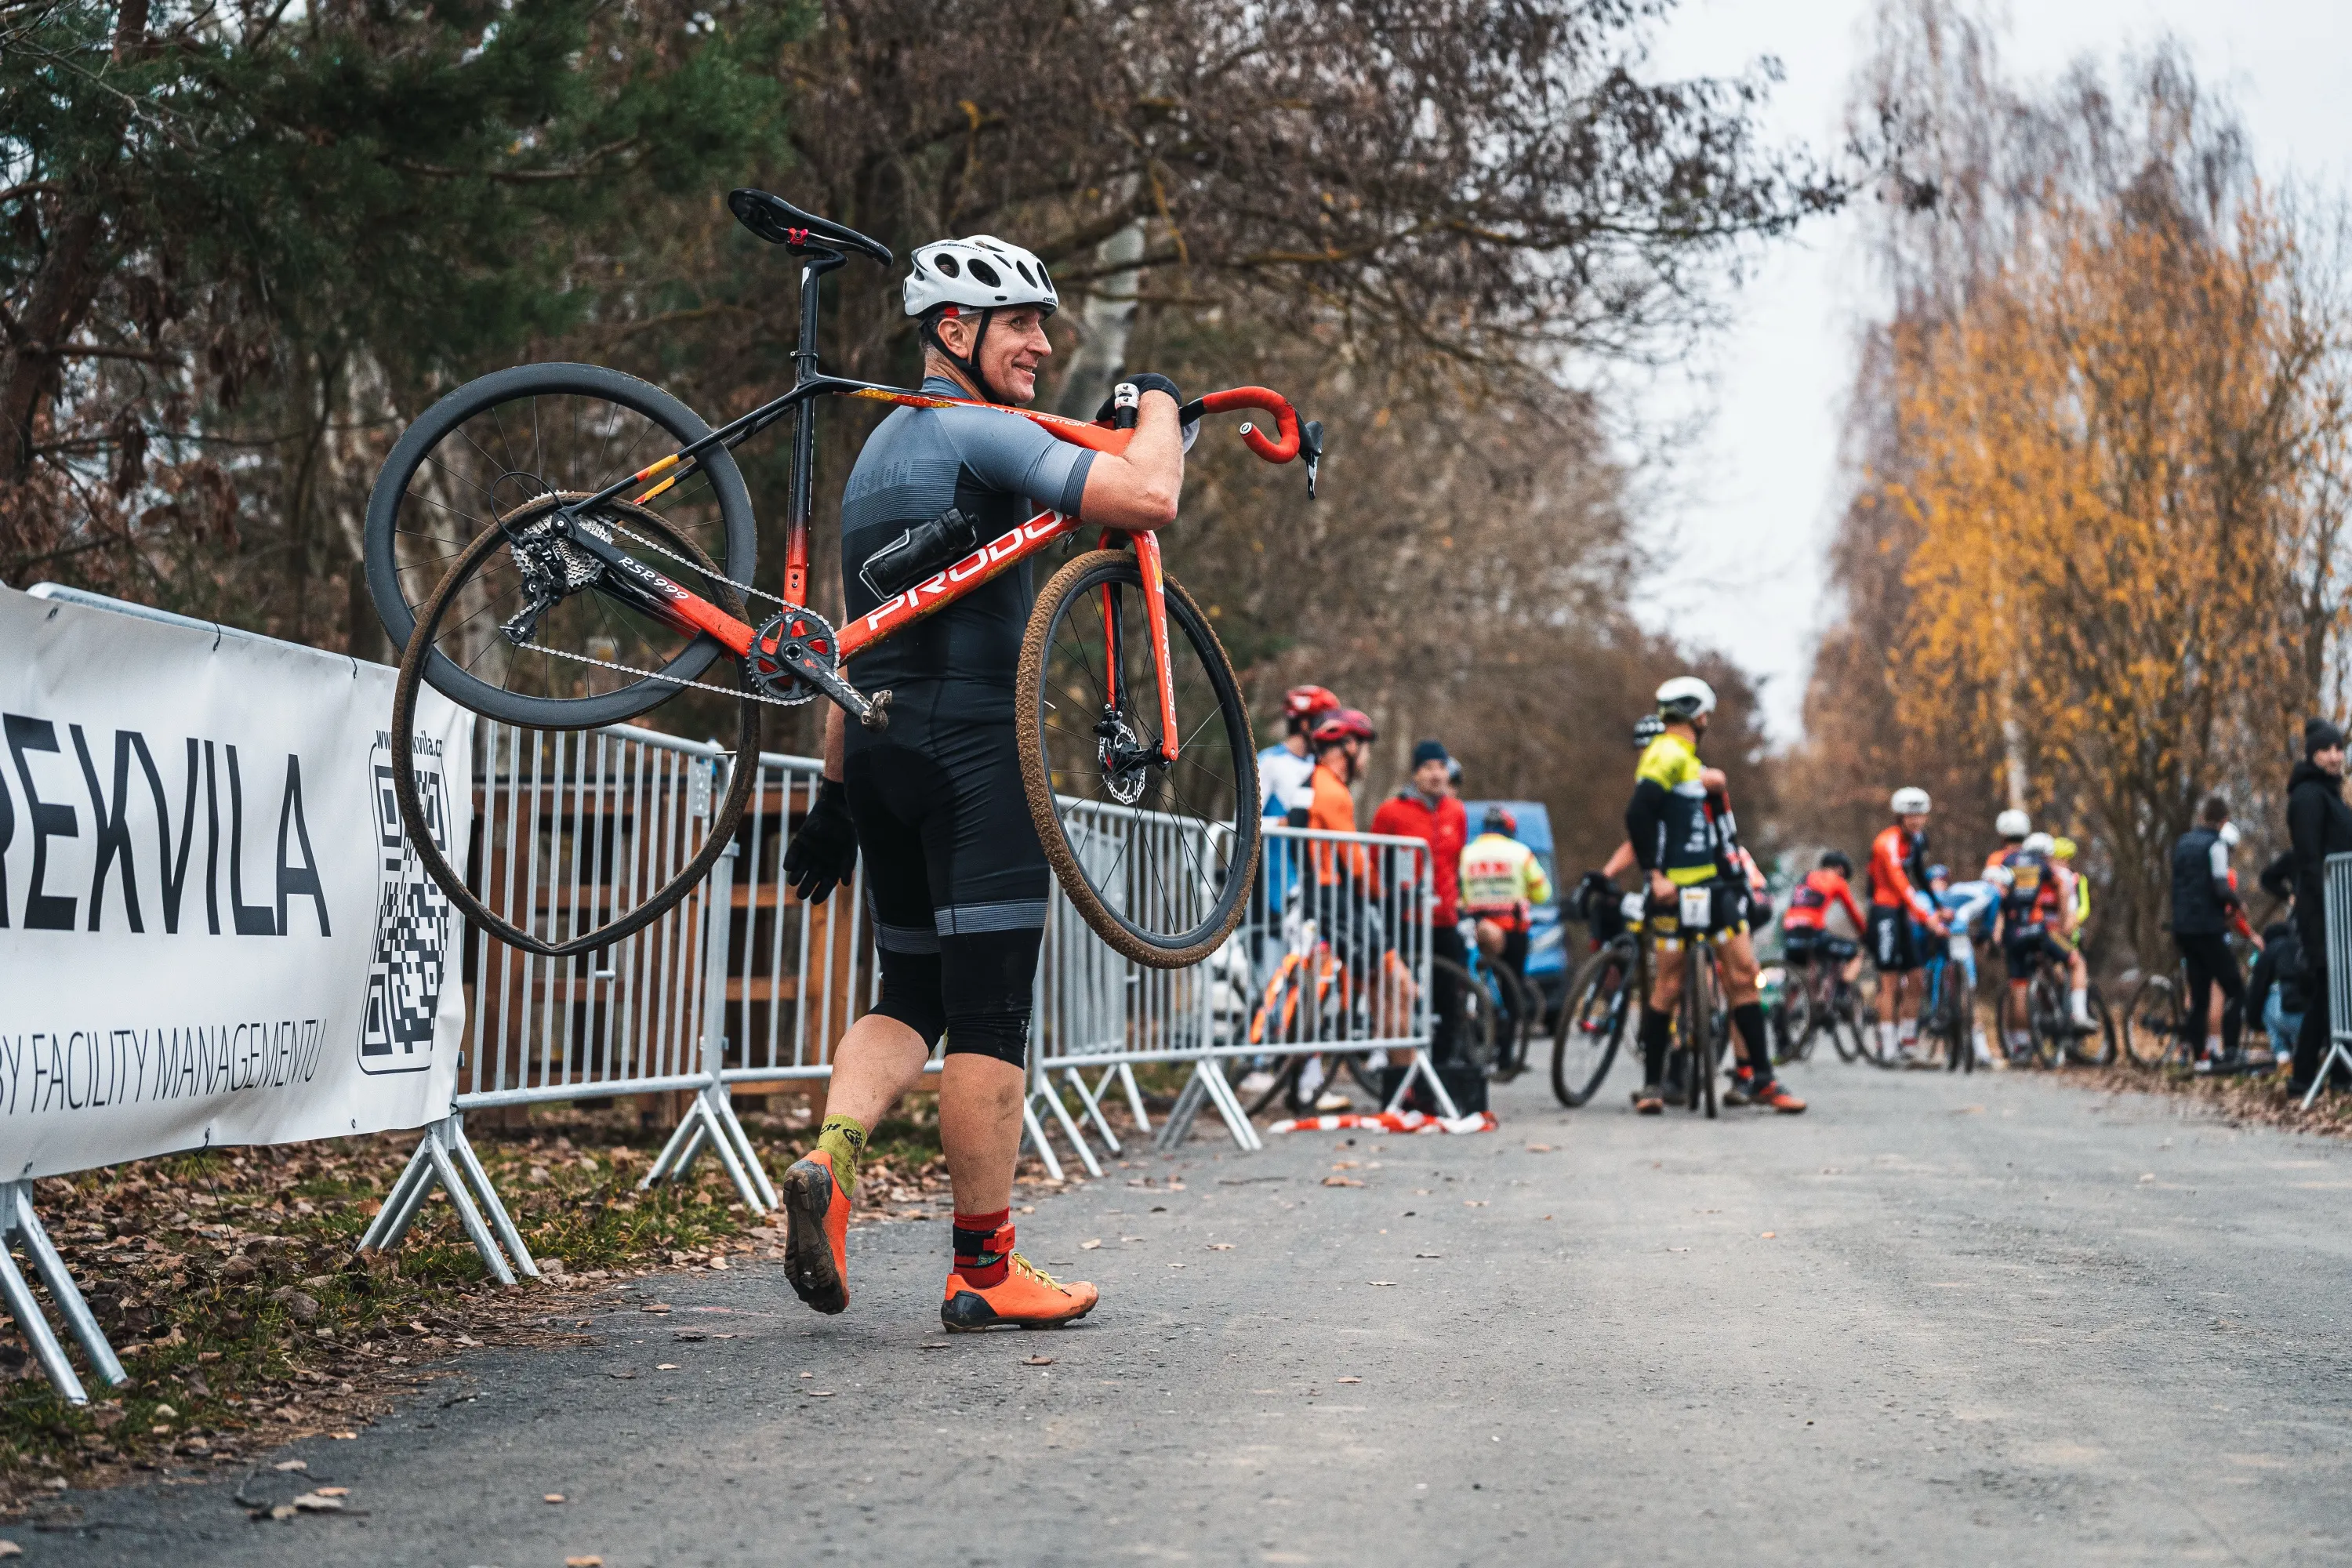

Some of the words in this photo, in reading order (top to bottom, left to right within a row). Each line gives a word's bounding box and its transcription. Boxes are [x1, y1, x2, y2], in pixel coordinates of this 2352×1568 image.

[1036, 415, 1087, 427] EDITION
[617, 556, 690, 601] RSR999
[866, 508, 1073, 631] PRODO
[1160, 615, 1177, 728] PRODOLI
[0, 712, 332, 937] EKVILA
[0, 1033, 22, 1116] Y
[31, 1029, 149, 1114] FACILITY
[153, 1018, 328, 1101] MANAGEMENTU
